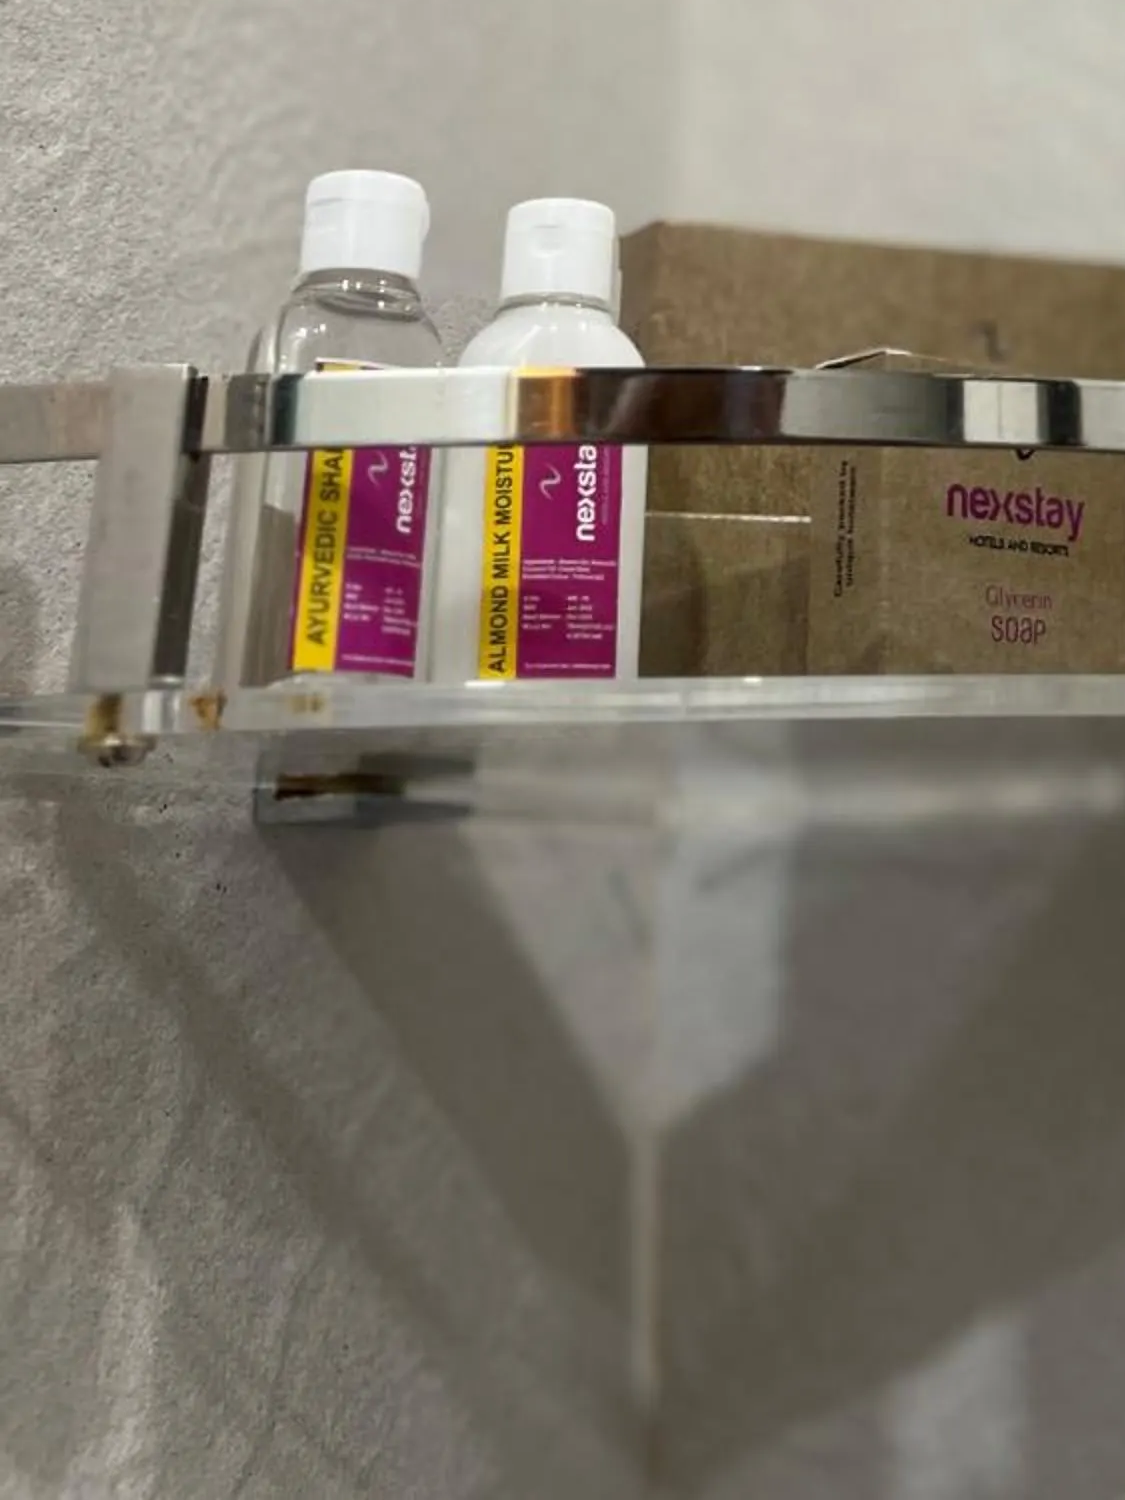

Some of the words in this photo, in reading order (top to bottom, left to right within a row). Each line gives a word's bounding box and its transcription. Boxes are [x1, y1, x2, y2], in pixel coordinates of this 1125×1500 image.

[319, 448, 344, 502] SHA
[396, 445, 417, 534] nexst
[494, 444, 515, 525] MOISTU
[574, 445, 597, 541] nexsta
[946, 483, 1086, 542] nexstay
[306, 509, 338, 645] AYURVEDIC
[492, 531, 511, 579] MILK
[487, 586, 508, 673] ALMOND
